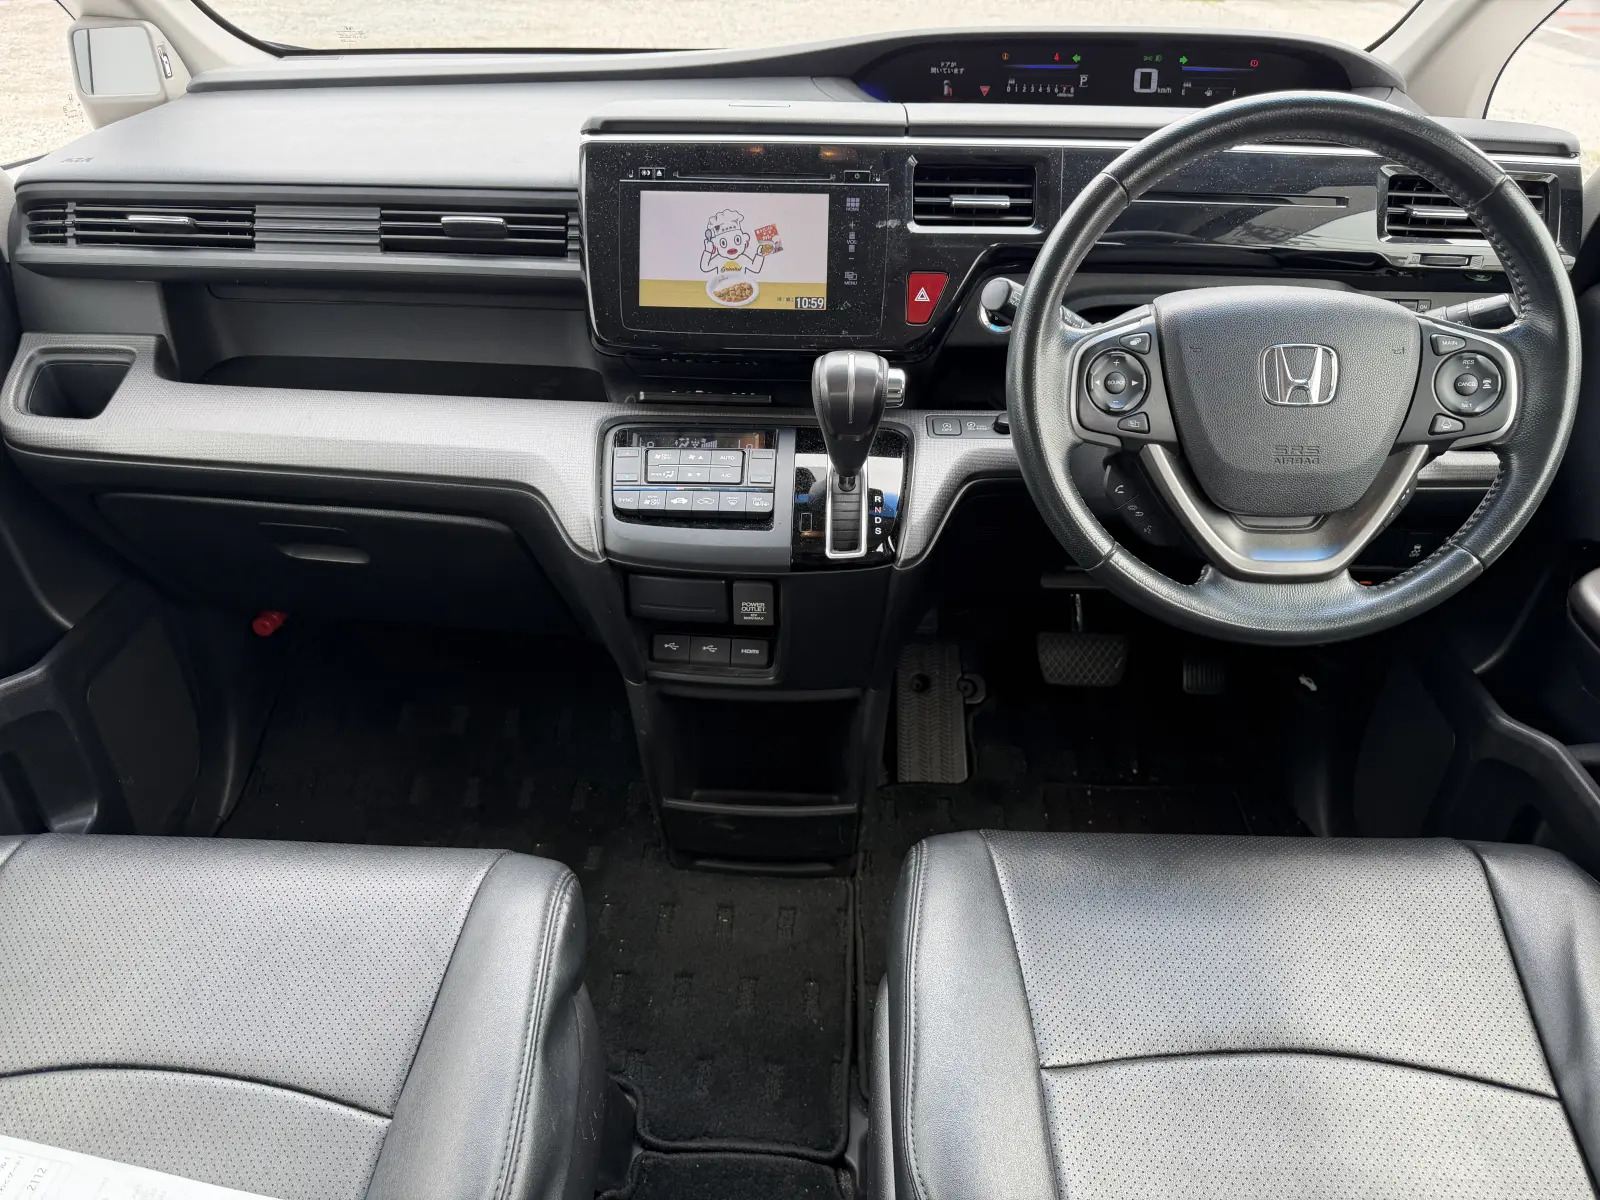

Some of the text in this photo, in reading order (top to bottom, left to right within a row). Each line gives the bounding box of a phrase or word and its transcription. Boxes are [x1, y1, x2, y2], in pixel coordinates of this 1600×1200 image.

[1079, 75, 1089, 87] P
[1133, 68, 1159, 93] 0
[1157, 86, 1172, 94] km/h
[796, 297, 824, 309] 10:59
[1273, 445, 1320, 454] SRS
[1274, 457, 1320, 465] AIRBAG
[874, 495, 882, 503] R
[874, 527, 882, 535] S
